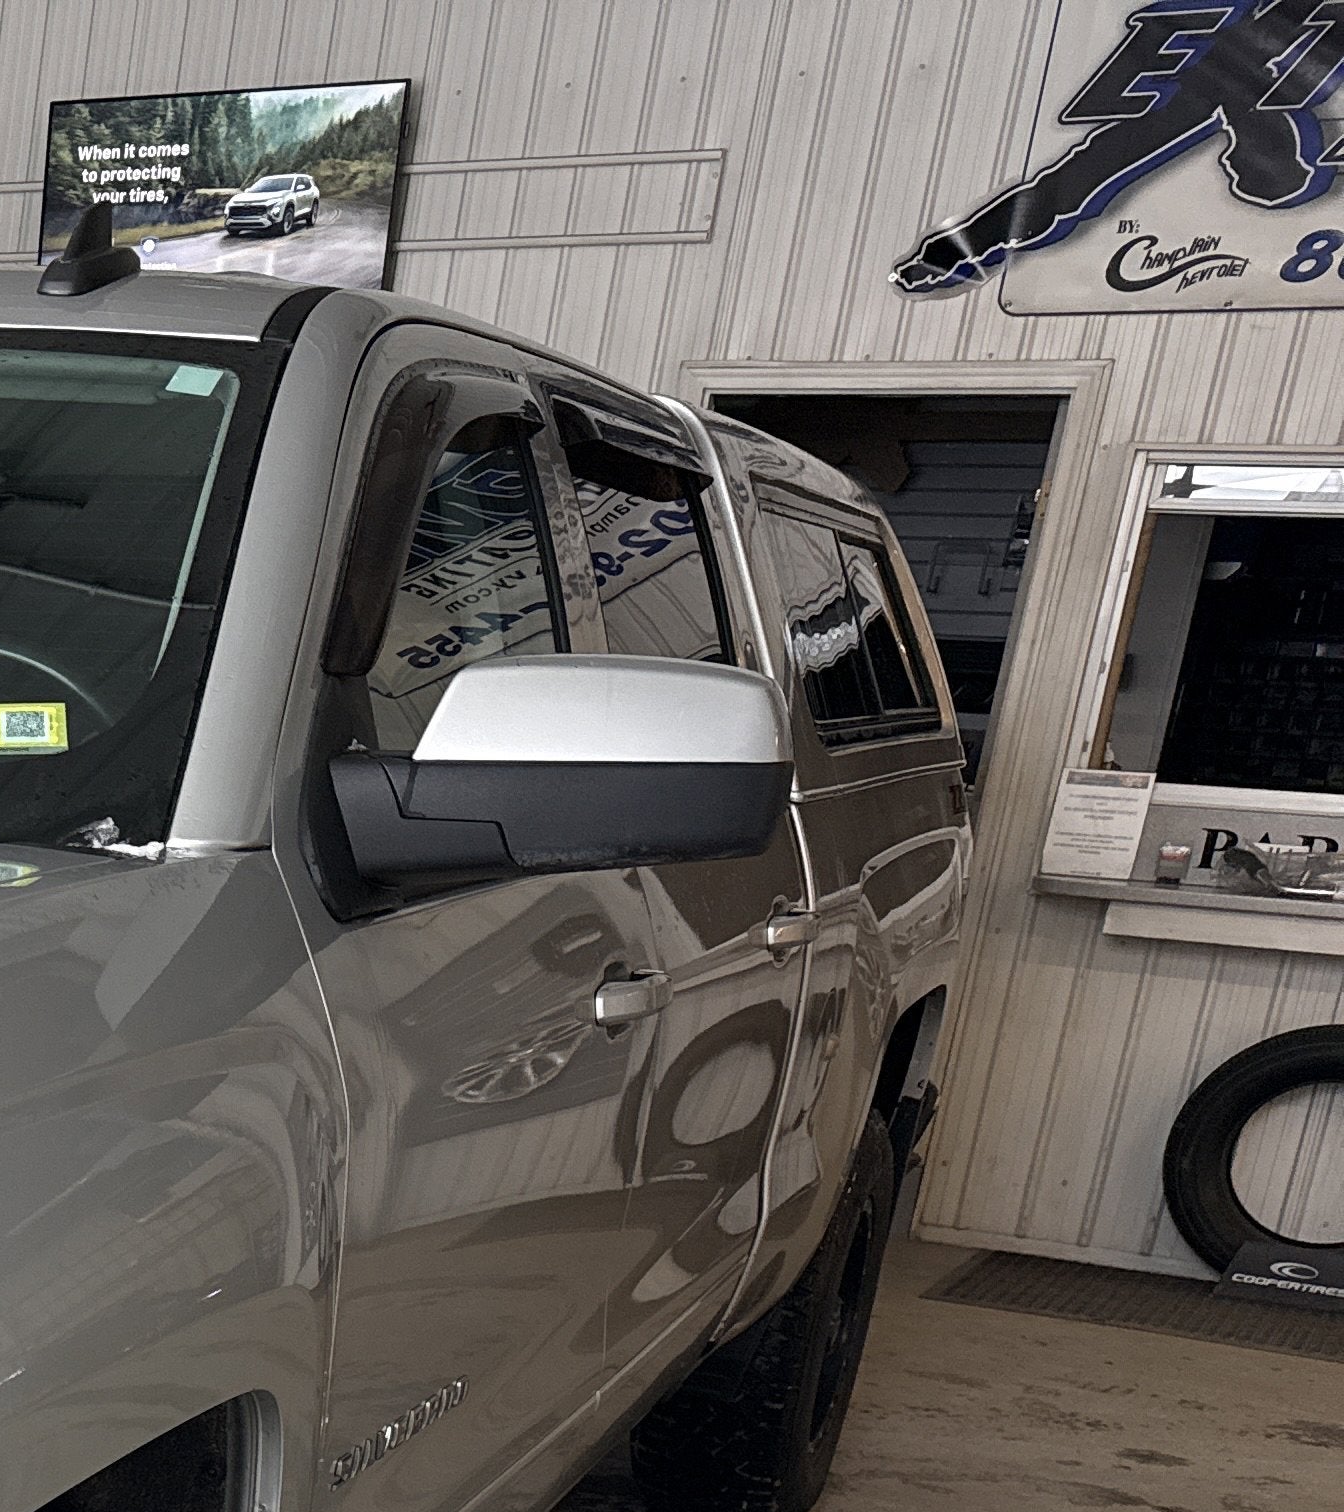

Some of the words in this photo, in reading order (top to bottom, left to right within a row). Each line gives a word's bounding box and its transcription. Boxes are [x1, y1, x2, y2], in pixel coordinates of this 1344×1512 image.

[78, 145, 121, 161] When
[124, 143, 135, 159] it
[138, 143, 190, 158] comes
[82, 169, 98, 183] to
[100, 163, 182, 185] protecting
[92, 191, 127, 204] your
[129, 186, 169, 204] tires,
[1117, 219, 1141, 234] BY:
